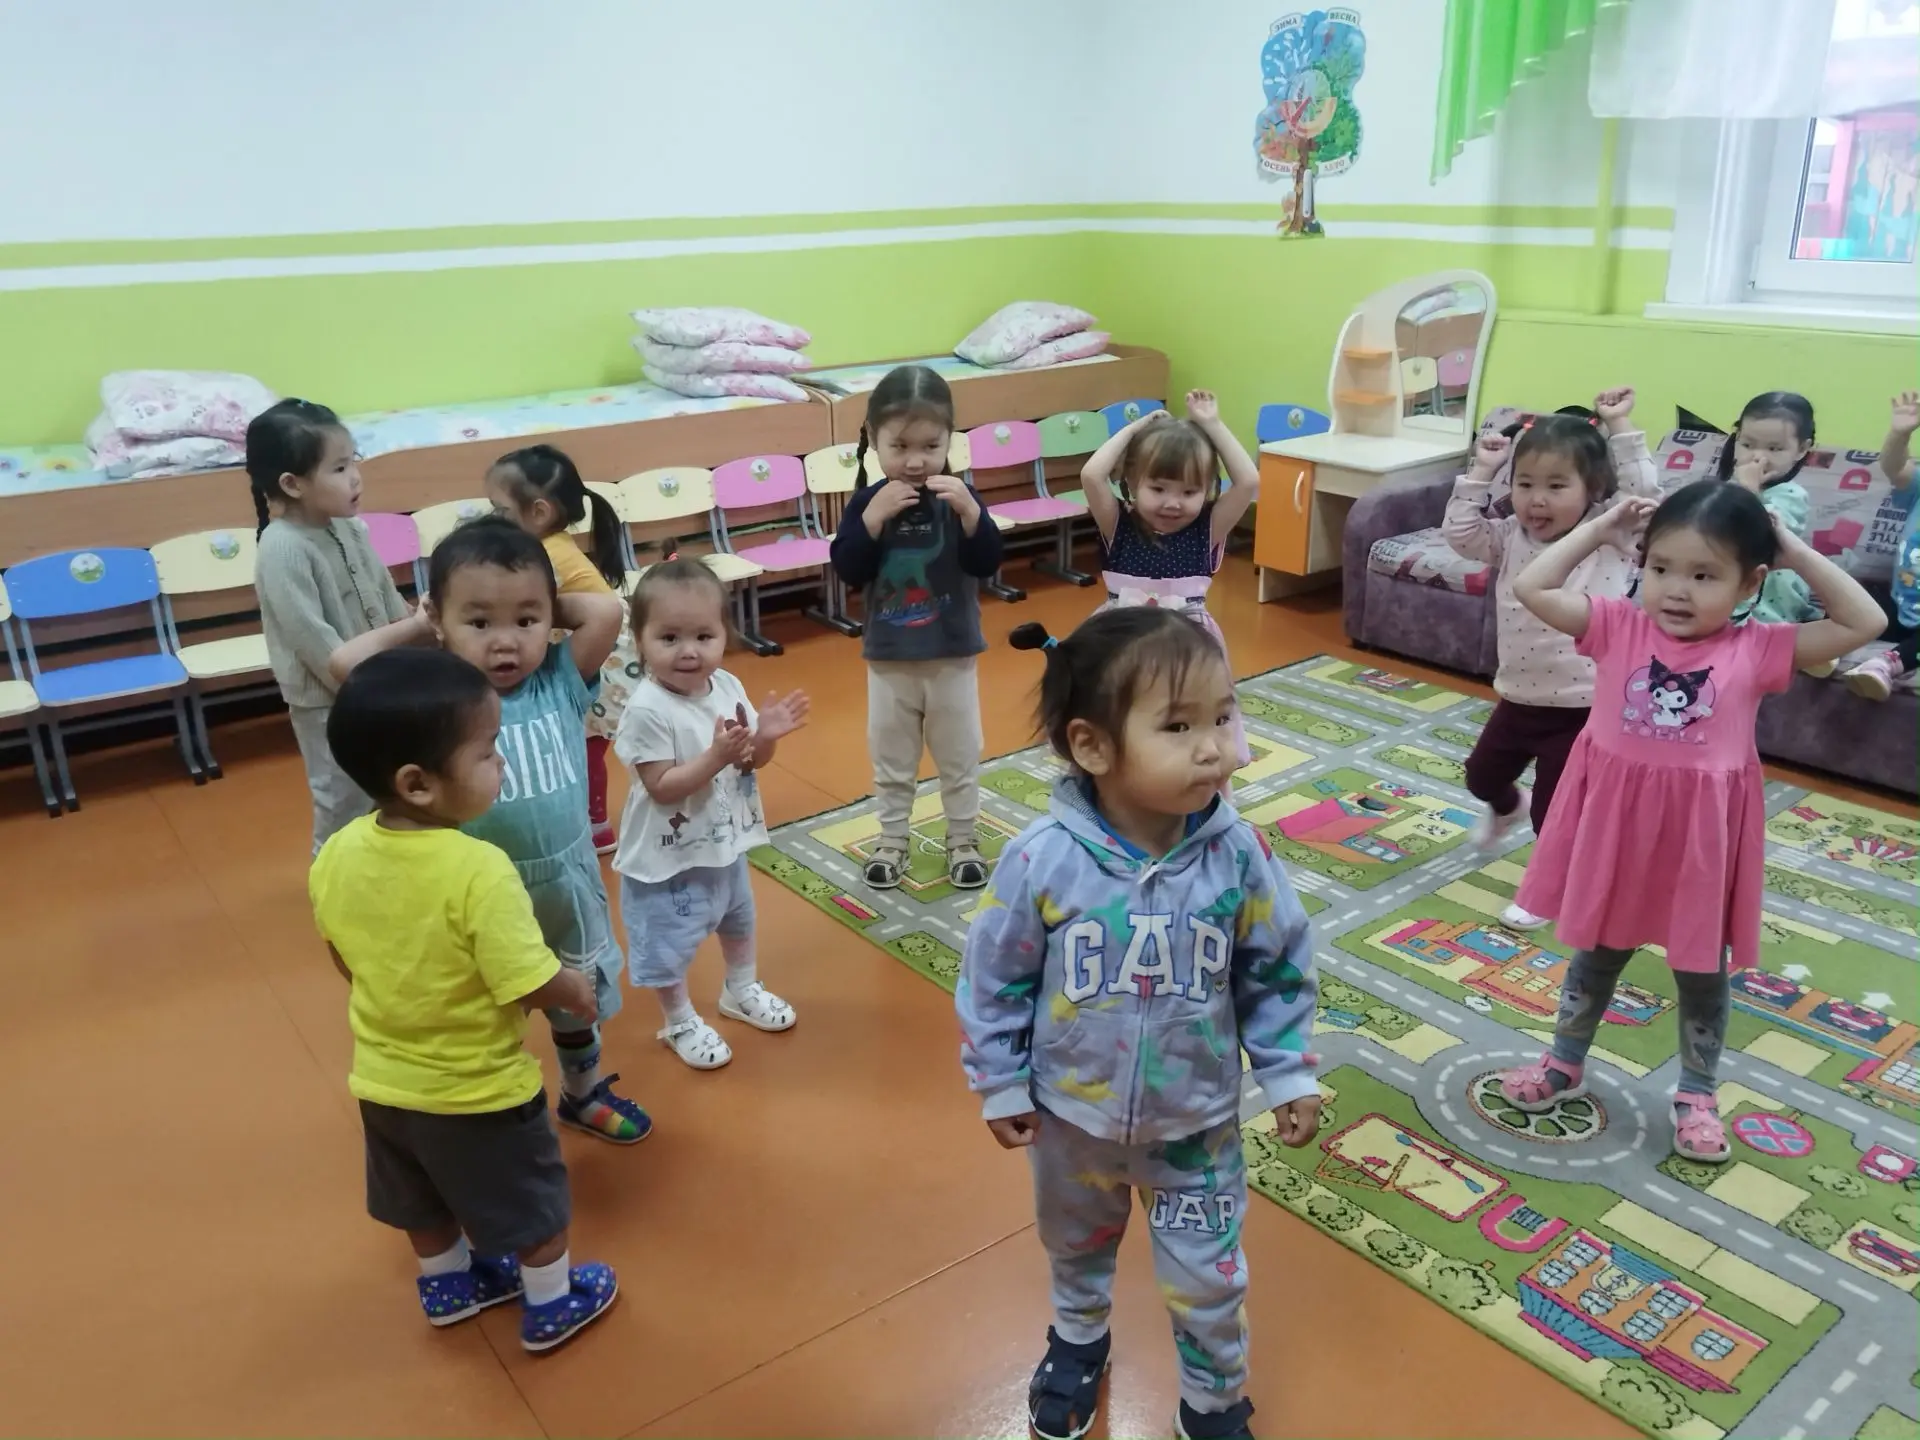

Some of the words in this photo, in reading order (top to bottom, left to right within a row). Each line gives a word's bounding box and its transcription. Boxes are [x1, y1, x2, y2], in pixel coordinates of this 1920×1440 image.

[1274, 17, 1298, 31] ЗИМА
[1329, 12, 1357, 24] ВЕСНА
[1263, 161, 1291, 173] ОСЕНЬ
[495, 712, 576, 802] SIGN
[1062, 912, 1232, 1003] GAP
[1149, 1188, 1236, 1234] GAP
